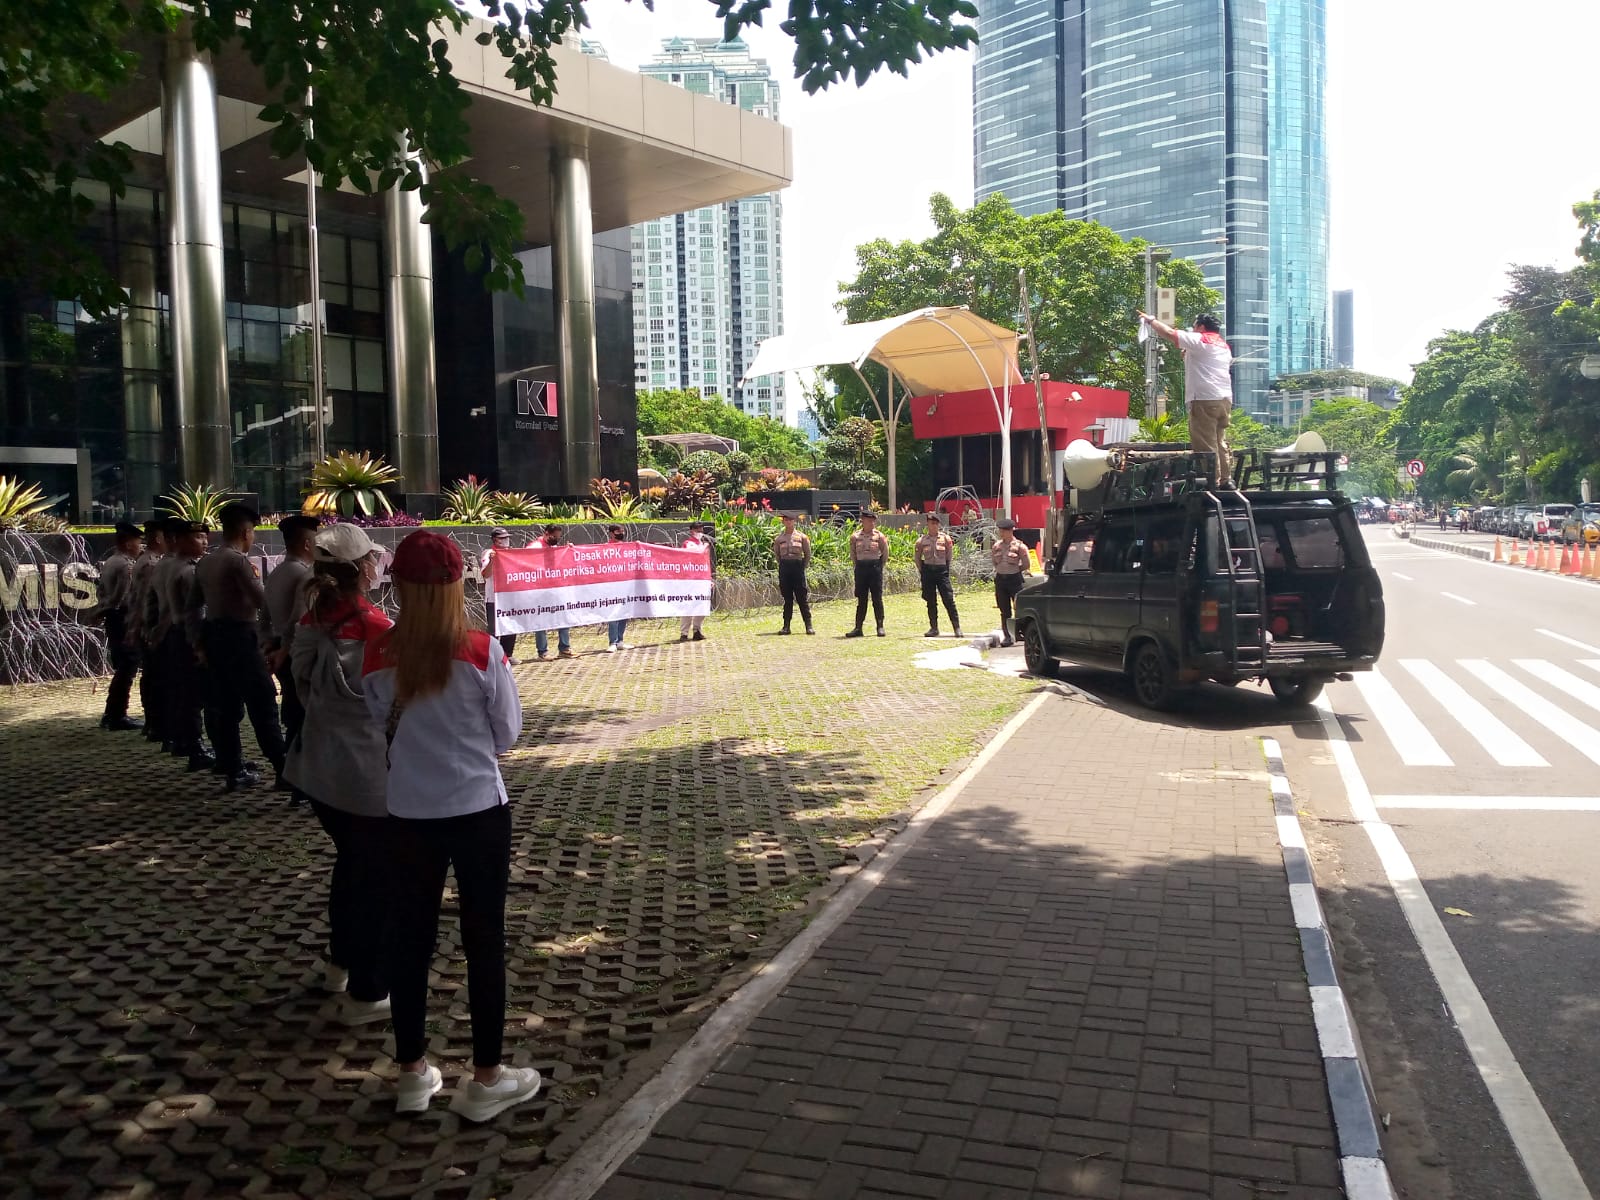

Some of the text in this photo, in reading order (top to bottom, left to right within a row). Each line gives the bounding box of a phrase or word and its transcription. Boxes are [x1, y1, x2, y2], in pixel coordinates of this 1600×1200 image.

[573, 548, 652, 561] Desak KPK segera
[507, 570, 542, 584] panggil
[545, 567, 561, 579] dan
[564, 566, 594, 578] periksa
[597, 561, 626, 575] Jokowi
[628, 561, 655, 572] terkait
[656, 562, 681, 574] utang
[496, 608, 536, 618] Prabowo
[537, 605, 565, 616] jangan
[566, 600, 598, 610] lindungi
[599, 596, 626, 608] jejaring
[627, 593, 658, 604] korupsi
[658, 593, 666, 602] di
[667, 594, 692, 603] proyek
